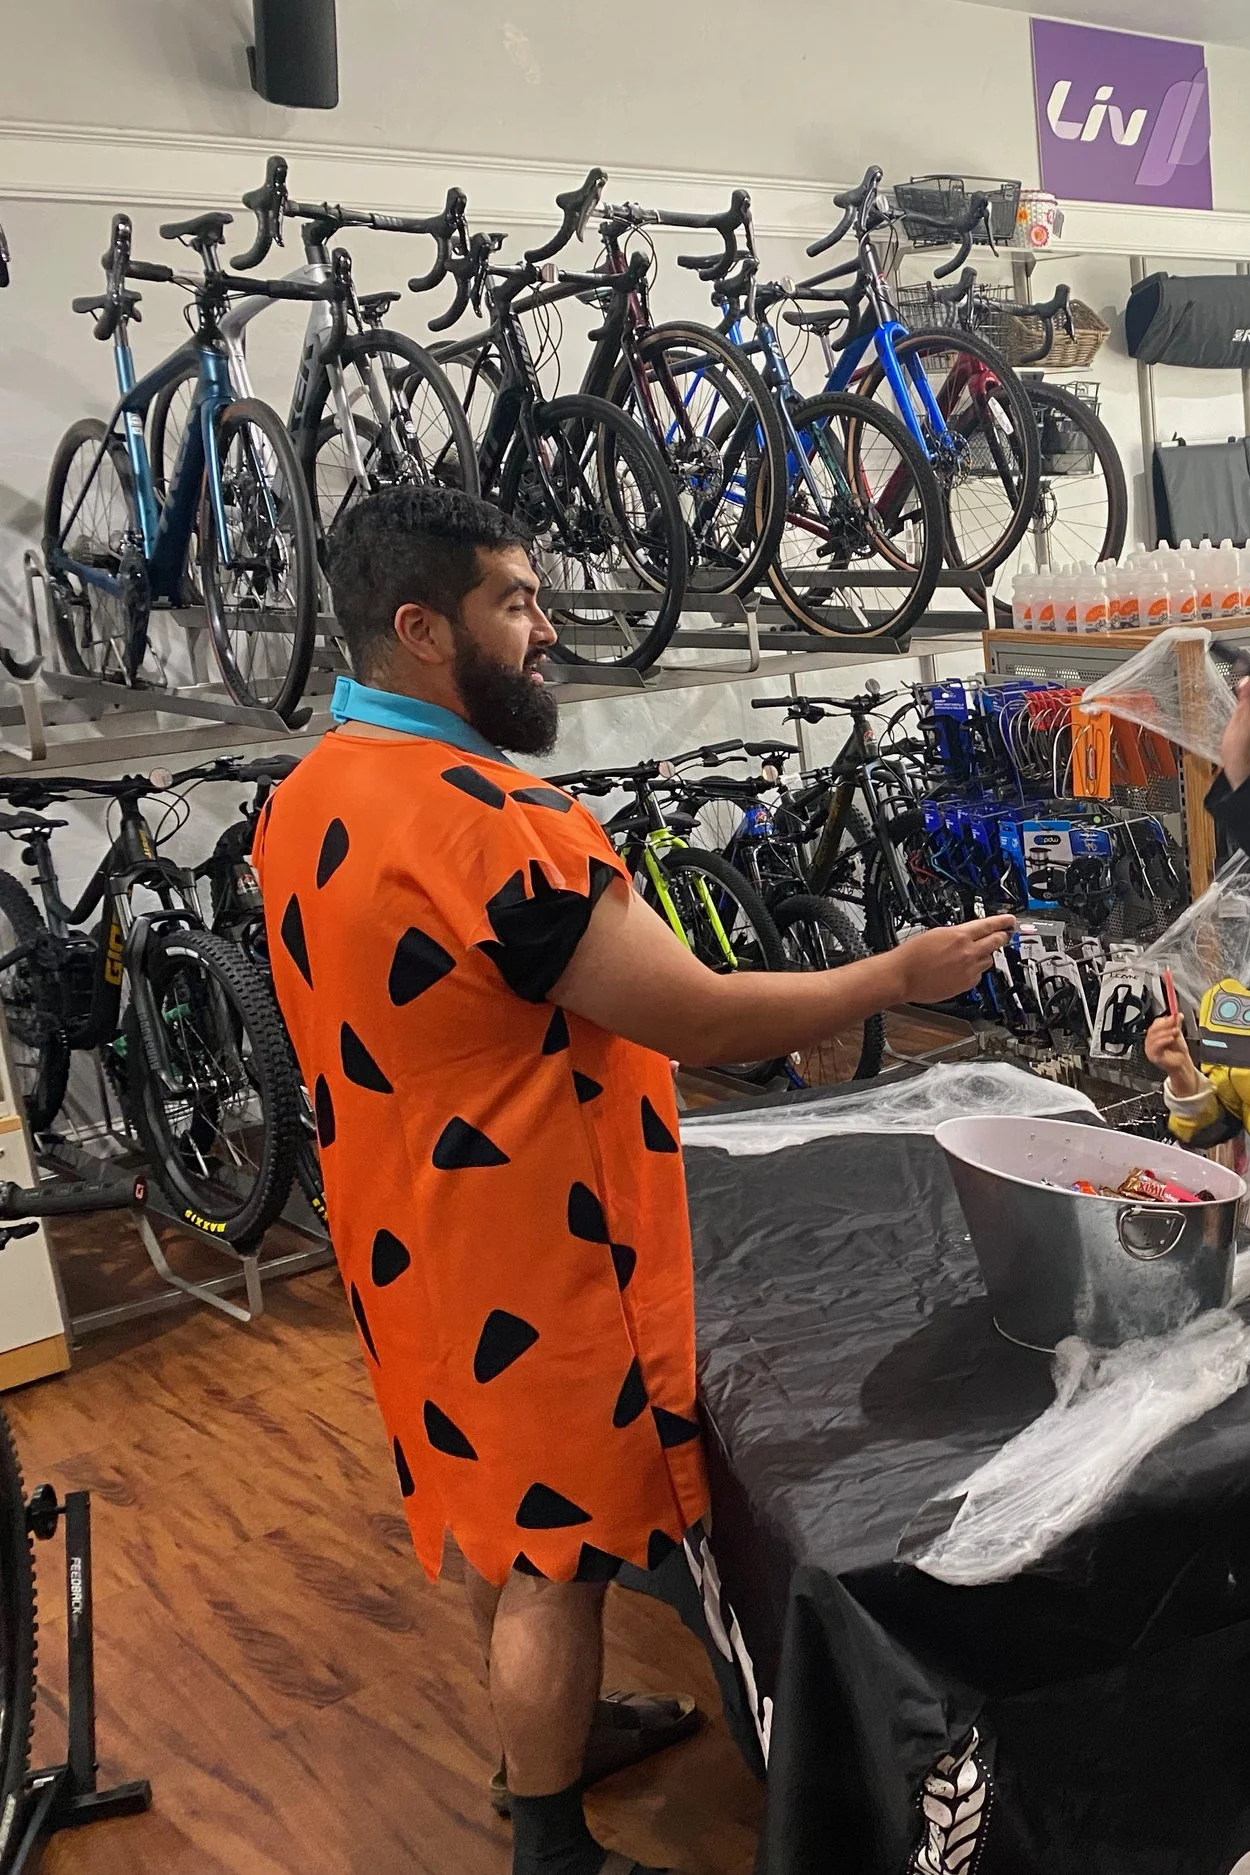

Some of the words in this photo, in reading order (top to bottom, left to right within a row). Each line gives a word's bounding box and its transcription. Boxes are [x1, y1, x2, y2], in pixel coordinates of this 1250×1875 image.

[1046, 80, 1148, 146] Liv
[104, 921, 126, 986] GIA
[184, 1209, 228, 1233] MAXXIS
[69, 1557, 83, 1615] FEEDBACK
